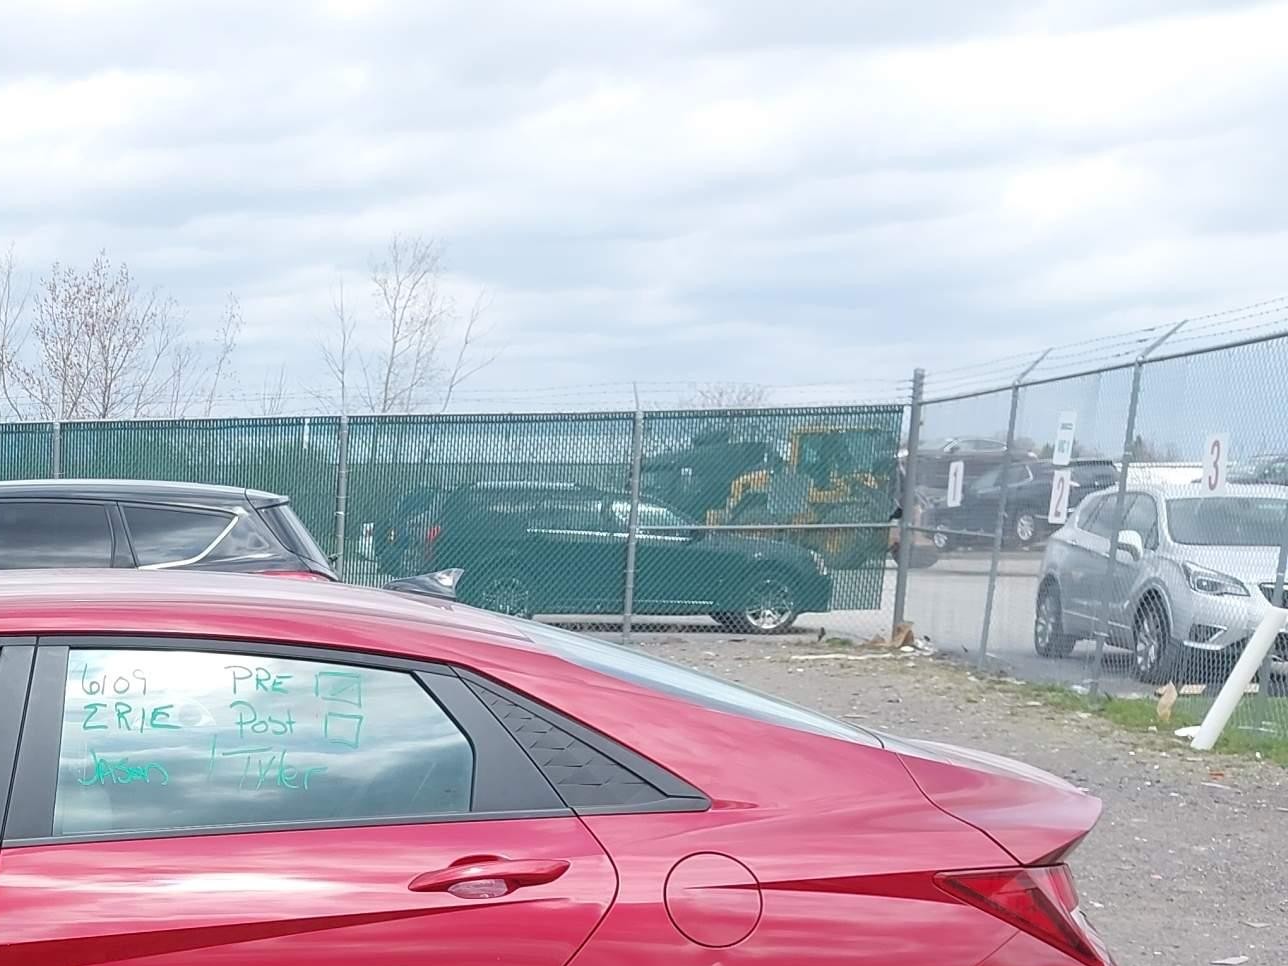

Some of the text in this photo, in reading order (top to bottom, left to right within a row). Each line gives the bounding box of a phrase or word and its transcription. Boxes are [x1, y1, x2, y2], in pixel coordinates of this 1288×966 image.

[1208, 440, 1221, 490] 3
[1054, 477, 1065, 518] 2
[224, 665, 294, 695] PRE
[230, 700, 297, 739] Post
